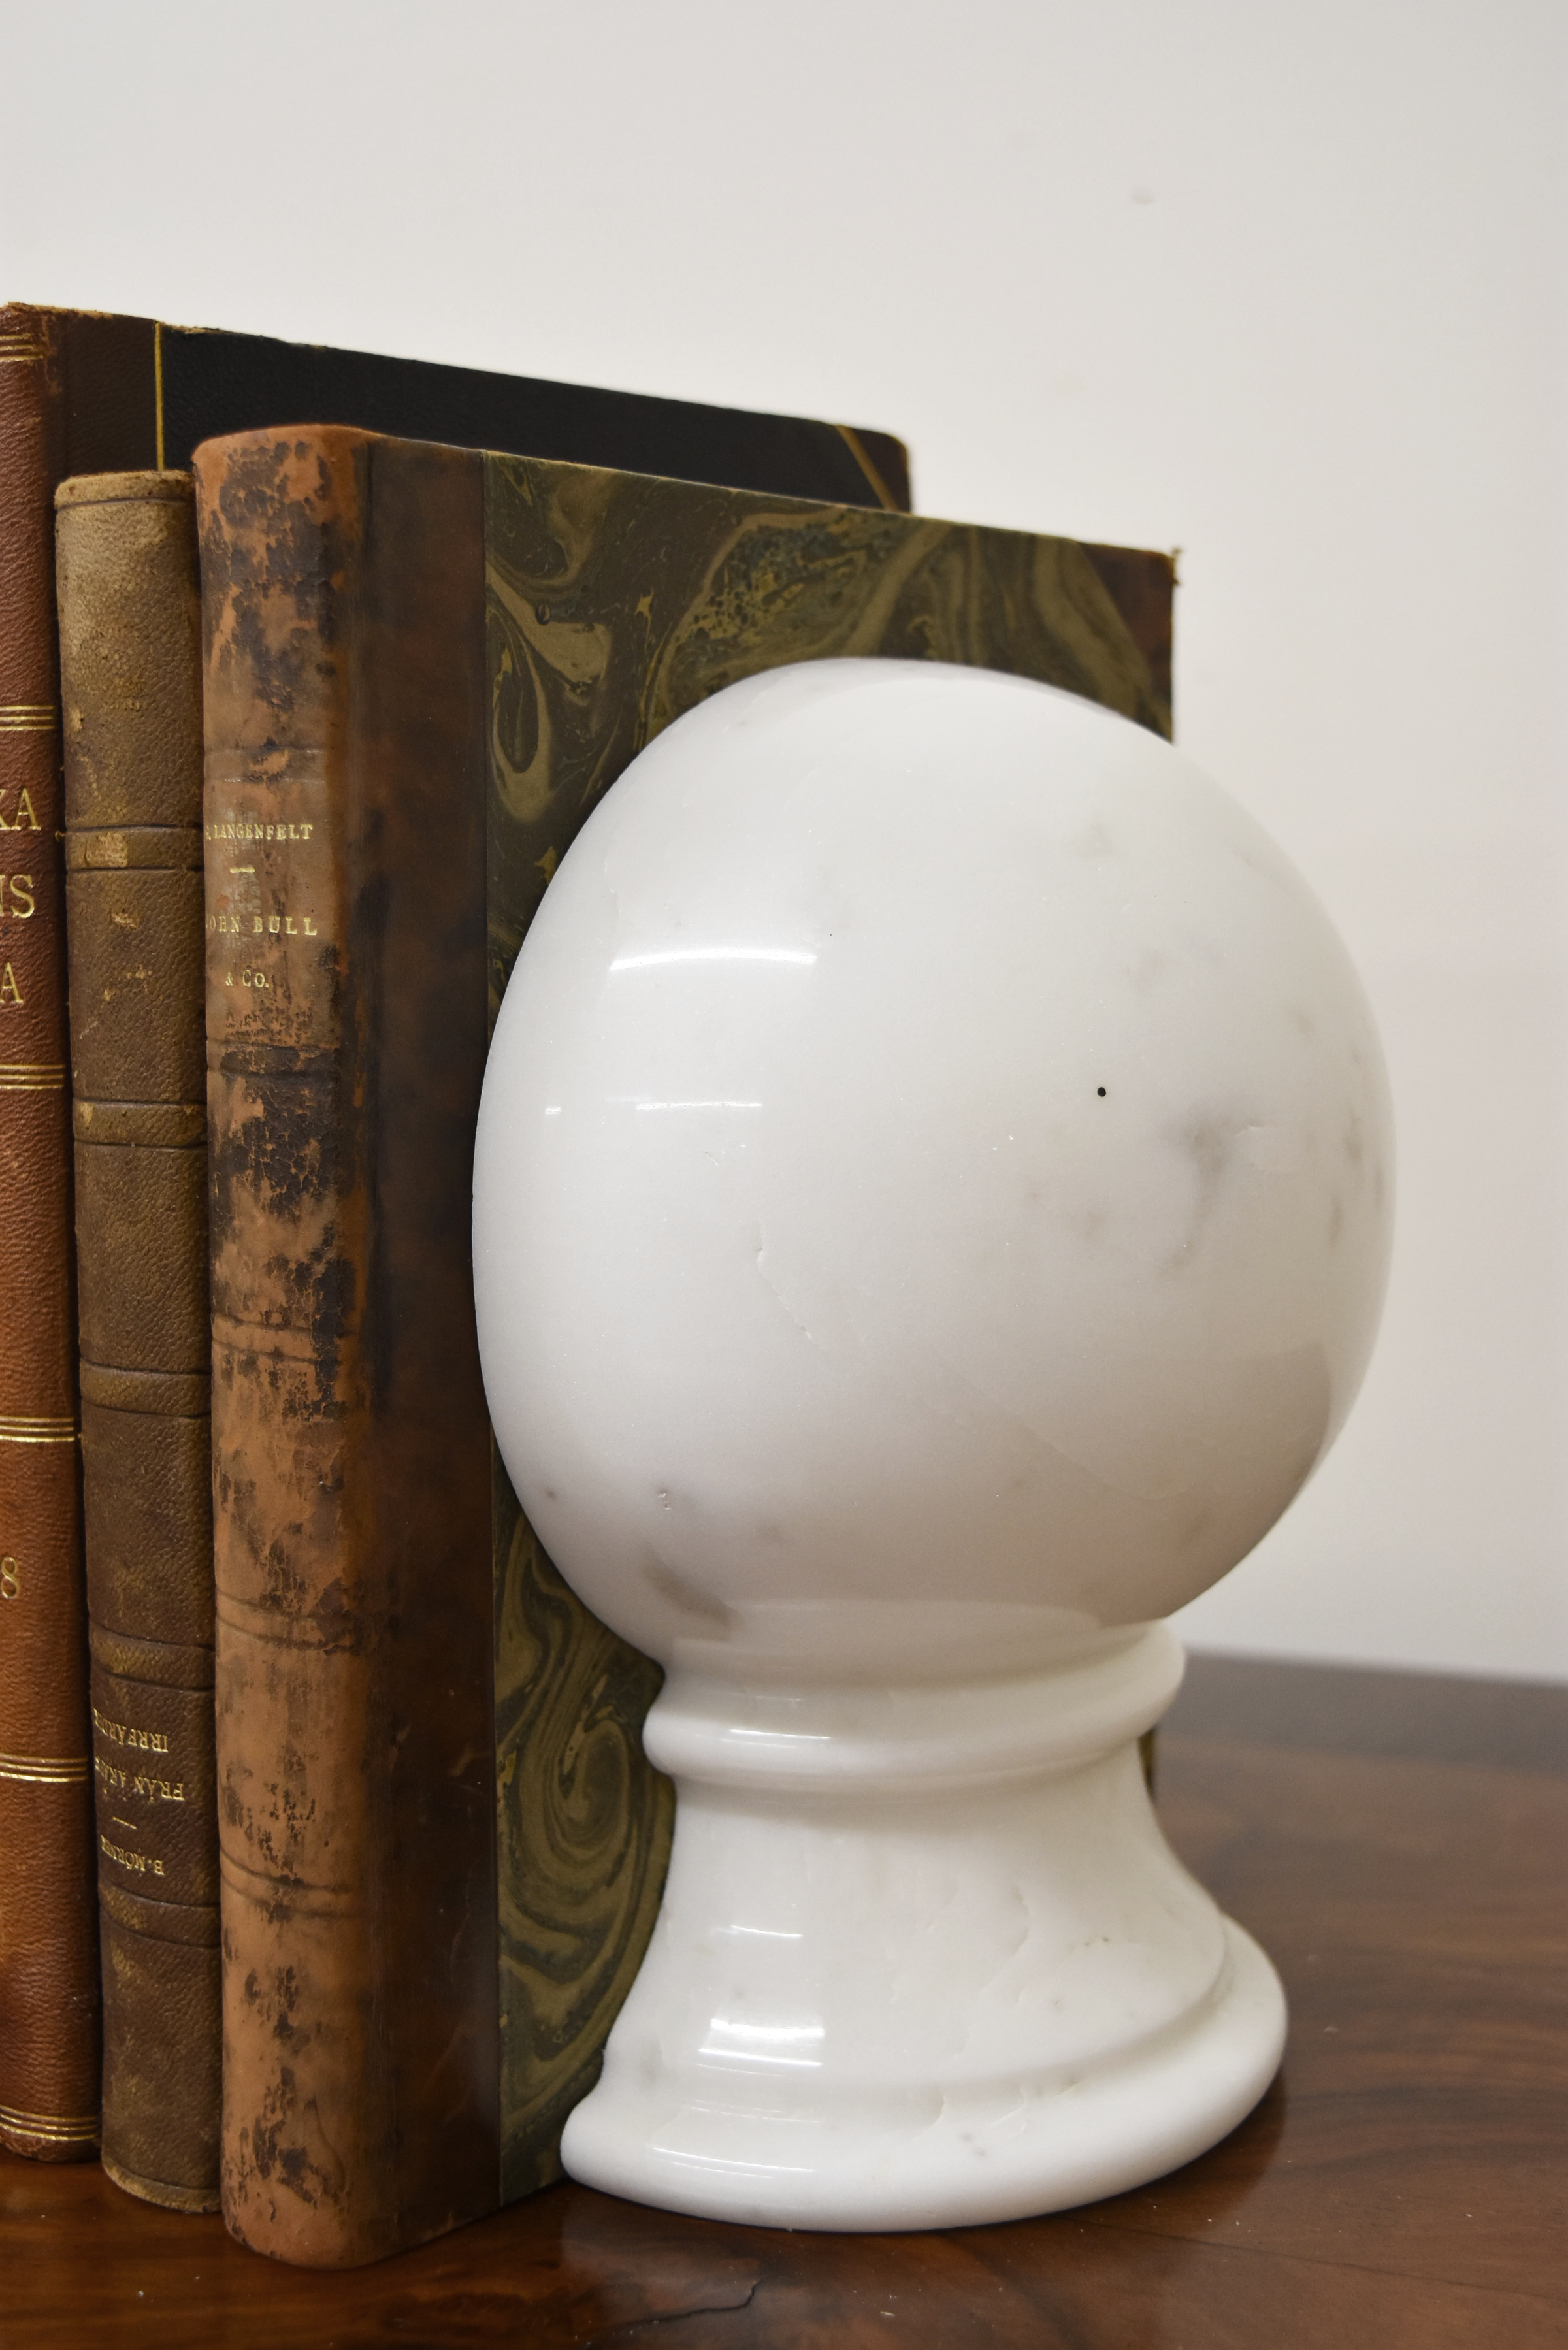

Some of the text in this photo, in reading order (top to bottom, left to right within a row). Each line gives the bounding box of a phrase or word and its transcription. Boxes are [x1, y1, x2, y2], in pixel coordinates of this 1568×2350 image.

[214, 824, 313, 840] LANGENFELT
[206, 915, 318, 936] OHN BULL
[133, 1778, 185, 1802] FRÅN
